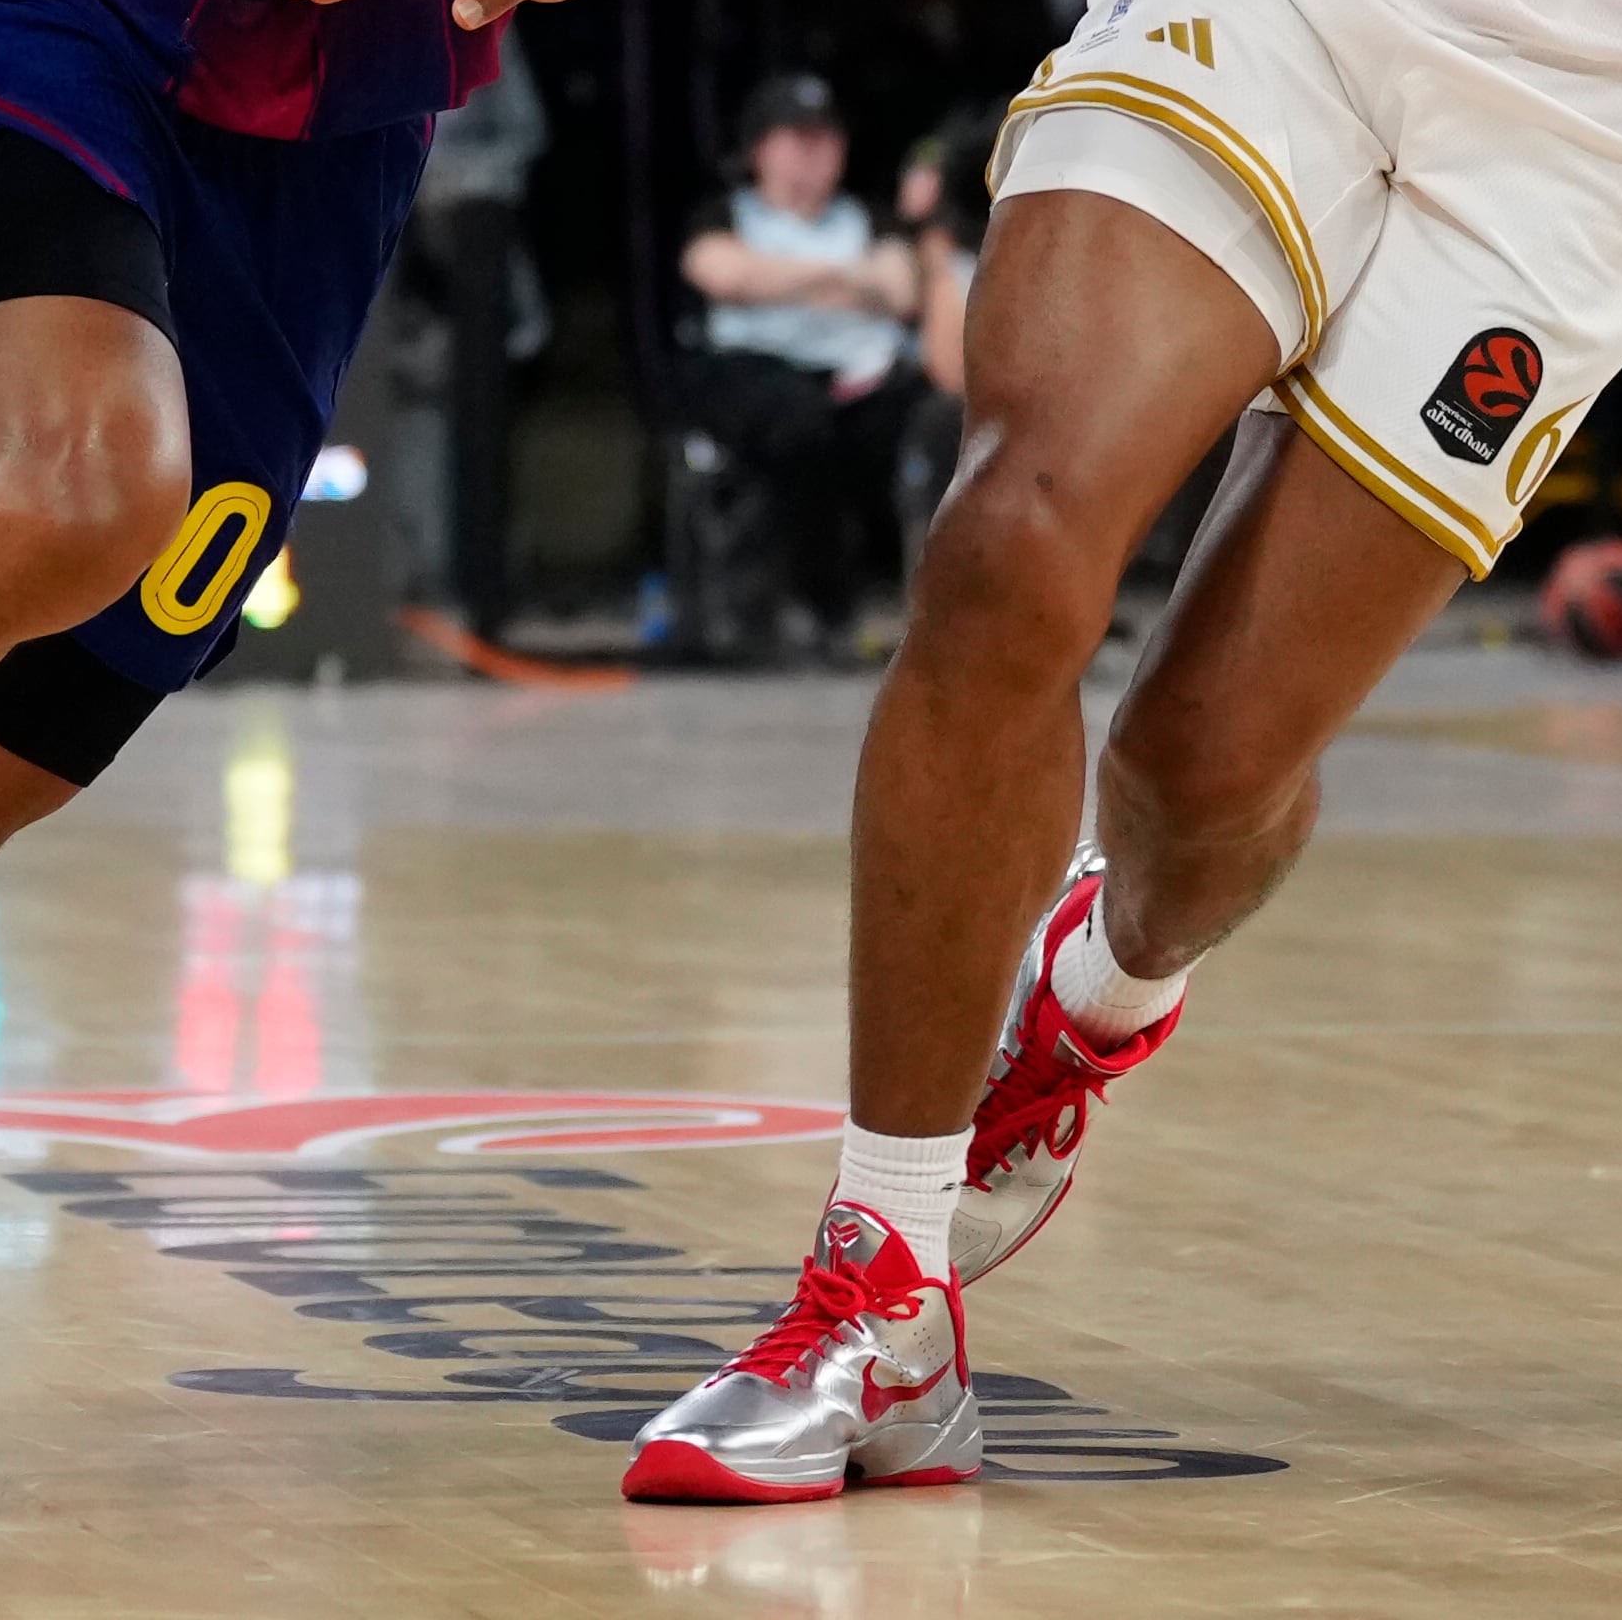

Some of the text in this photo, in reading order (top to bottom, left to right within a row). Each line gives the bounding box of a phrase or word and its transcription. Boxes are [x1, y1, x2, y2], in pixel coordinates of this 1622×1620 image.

[1426, 407, 1496, 461] abu dhabi
[140, 481, 272, 636] 0
